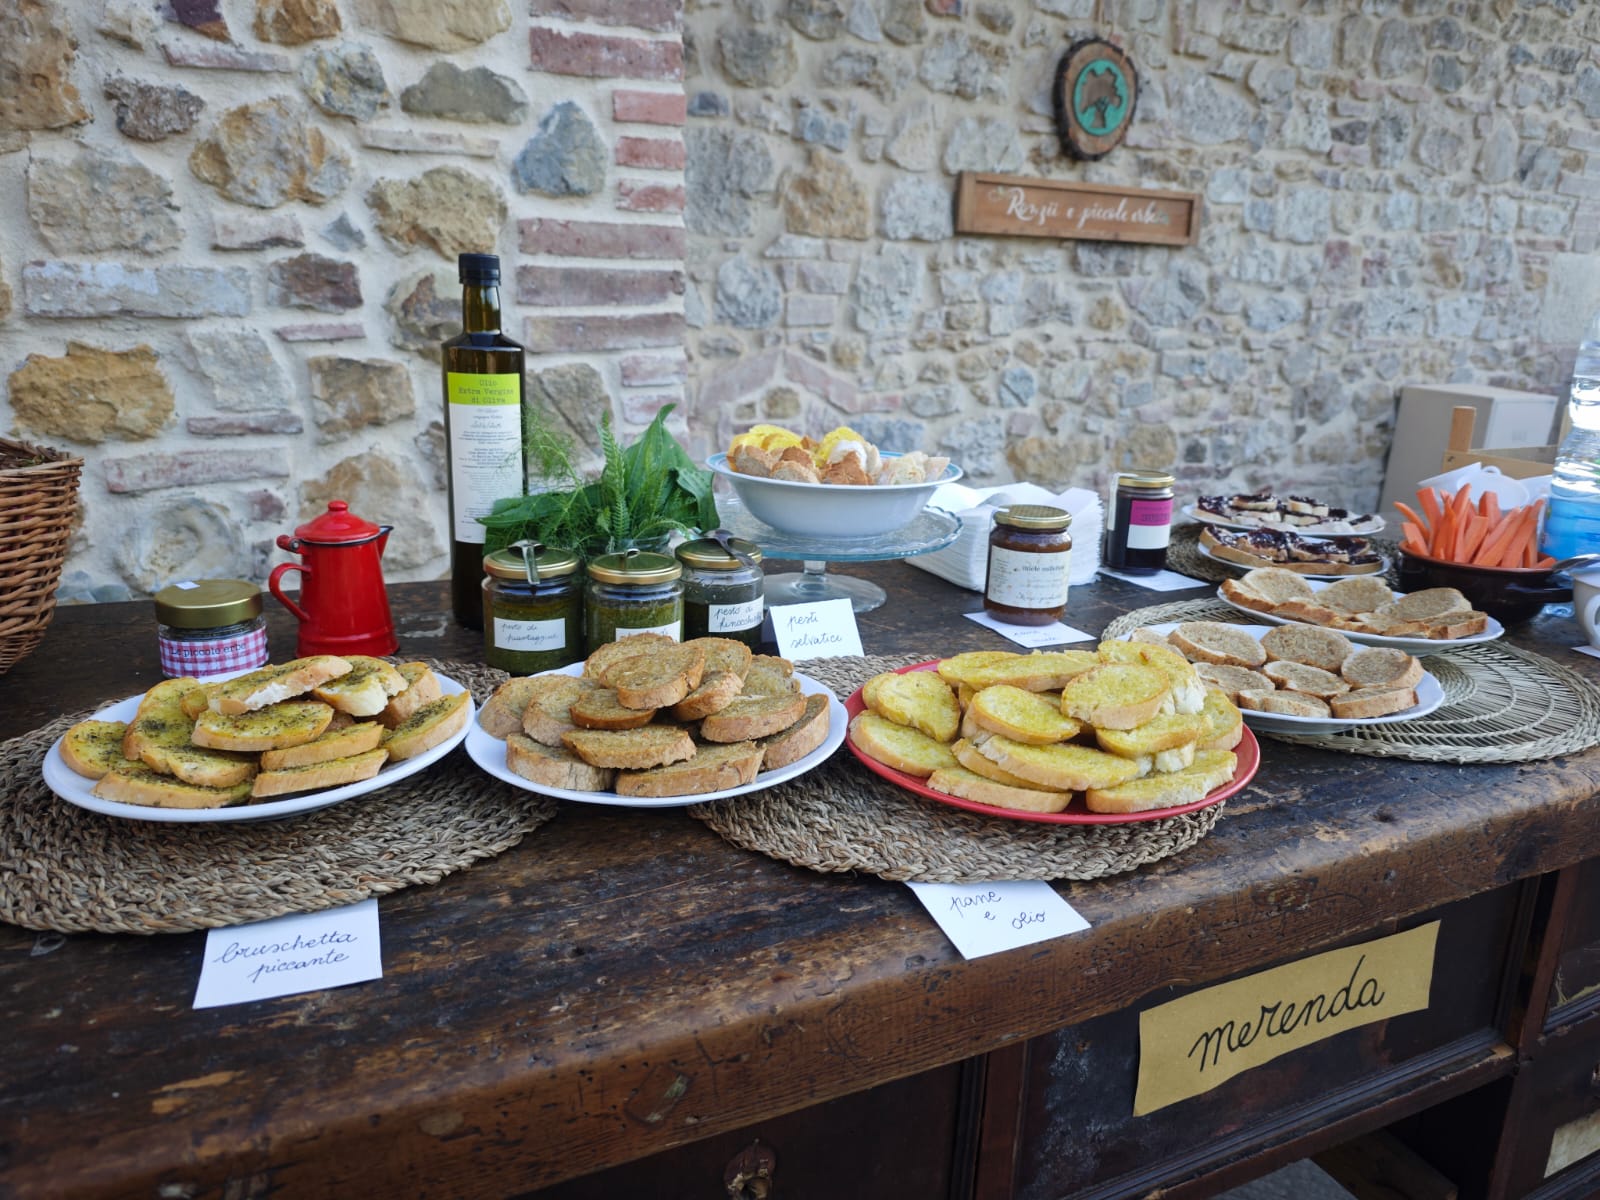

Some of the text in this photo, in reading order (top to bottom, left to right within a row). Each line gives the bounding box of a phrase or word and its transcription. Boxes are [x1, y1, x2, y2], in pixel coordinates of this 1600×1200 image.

[1066, 206, 1074, 219] e
[458, 387, 481, 395] Extra
[183, 648, 220, 657] piccole
[950, 890, 1002, 918] pane
[984, 911, 1046, 930] e olio
[212, 930, 358, 964] bruschetta
[248, 948, 351, 984] piccante
[1187, 954, 1386, 1073] merenda
